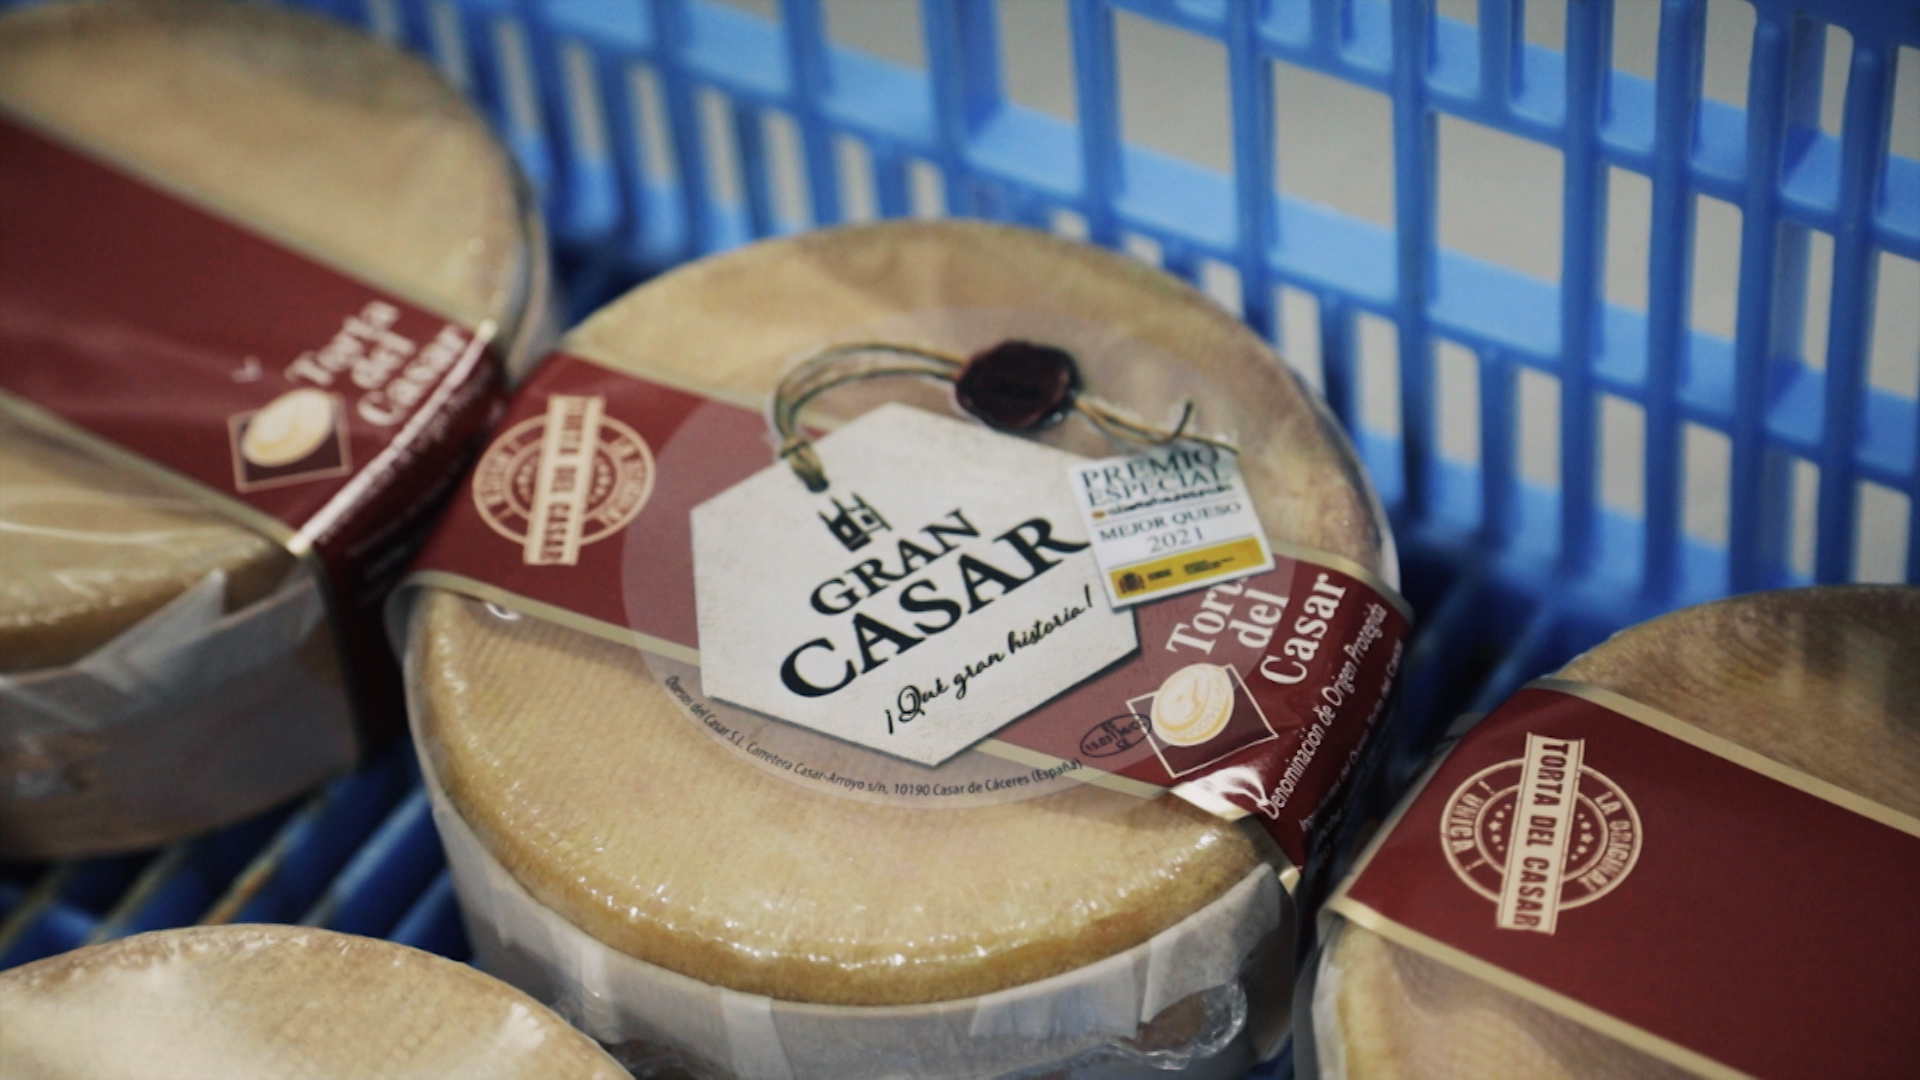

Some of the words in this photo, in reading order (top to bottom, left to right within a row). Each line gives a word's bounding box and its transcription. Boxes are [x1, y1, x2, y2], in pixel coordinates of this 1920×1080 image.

[1086, 467, 1232, 507] ESPECIAL
[1100, 516, 1166, 541] MEJOR
[1172, 501, 1242, 525] QUESO
[1149, 527, 1205, 552] 2021
[809, 507, 981, 616] GRAN
[779, 517, 1091, 698] CASAR
[1165, 577, 1249, 656] Tort
[1227, 588, 1290, 649] del
[1260, 573, 1347, 684] Casar
[1343, 603, 1388, 666] Protegida
[953, 651, 1005, 700] gran
[1321, 661, 1356, 706] Origen
[1313, 704, 1336, 726] de
[703, 713, 729, 737] Casar
[746, 740, 793, 770] Carretera
[793, 763, 865, 793] Casar-Arroyo
[894, 782, 930, 796] 10190
[932, 783, 965, 796] Casar
[967, 781, 983, 794] de
[985, 775, 1030, 792] Cáceres
[1032, 758, 1083, 784] (España)
[1532, 743, 1570, 807] TORTA
[1525, 814, 1558, 848] DEL
[1593, 790, 1622, 816] LA
[1512, 856, 1551, 929] CASAR
